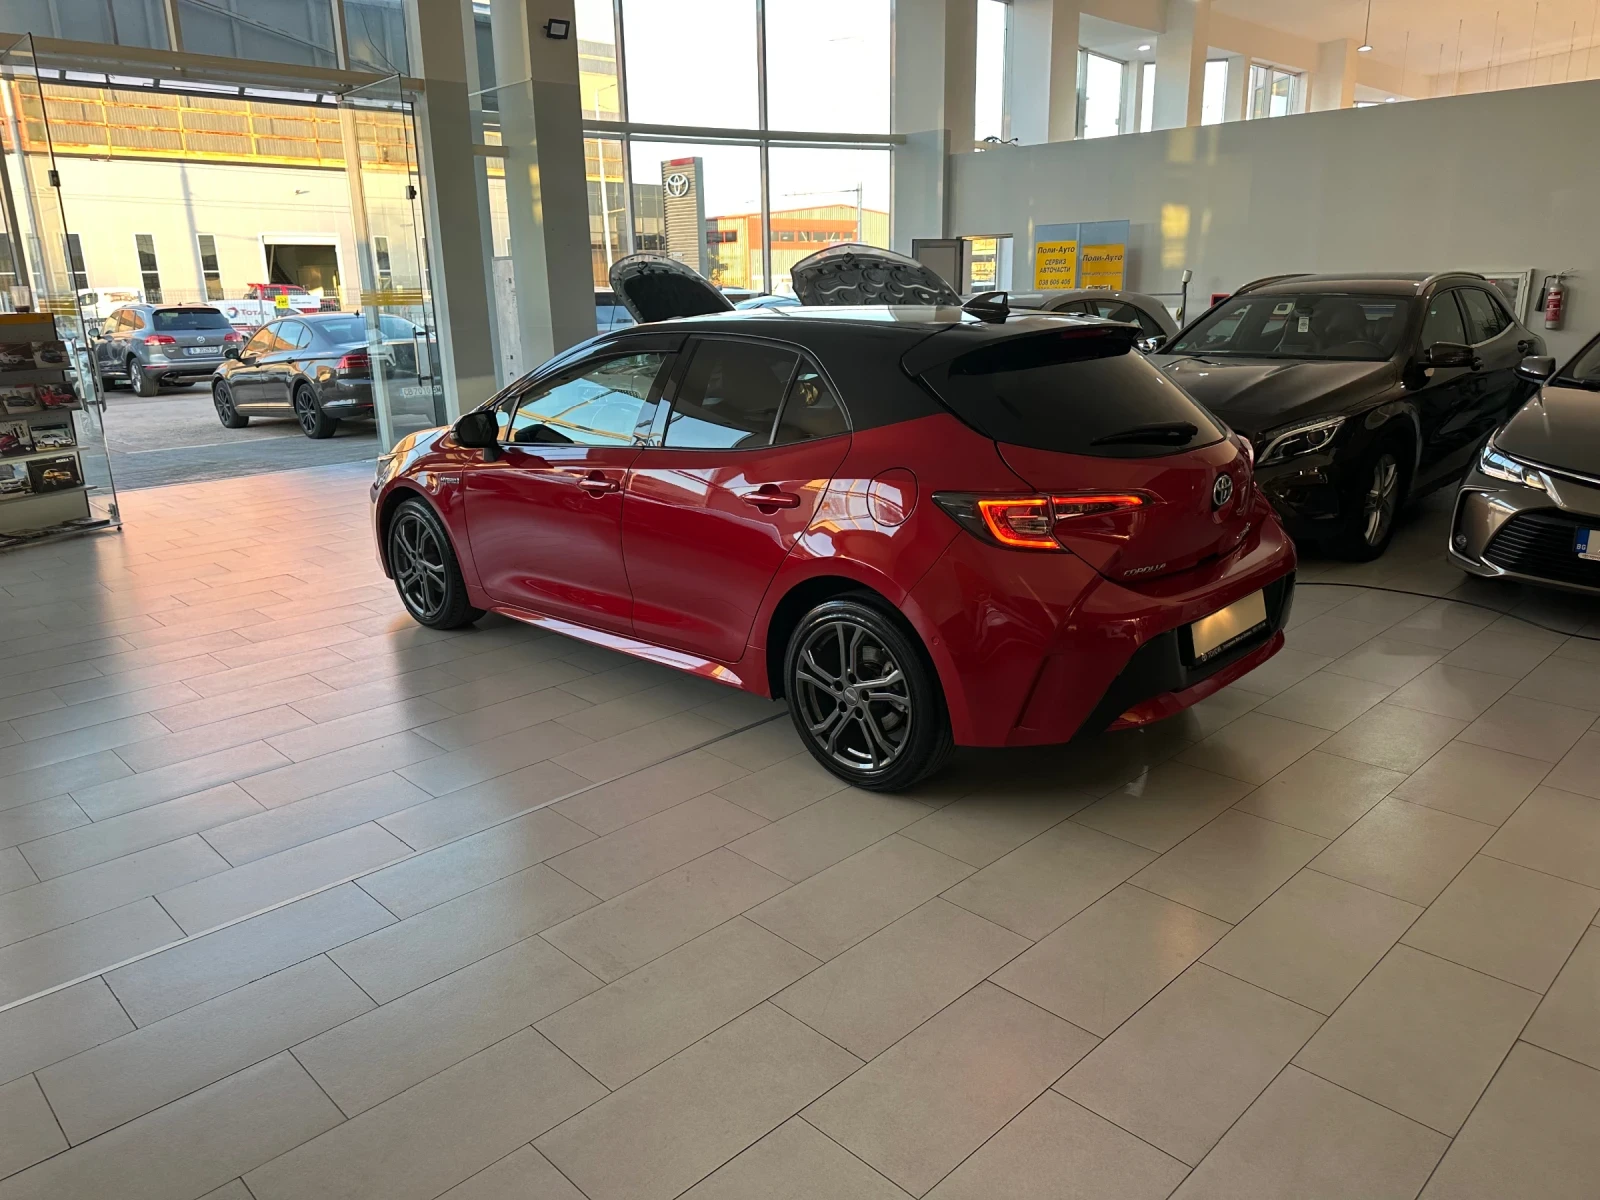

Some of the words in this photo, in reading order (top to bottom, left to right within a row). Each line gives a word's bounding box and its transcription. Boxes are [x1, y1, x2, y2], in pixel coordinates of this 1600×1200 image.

[1037, 246, 1075, 254] Поли-Ауто
[1083, 254, 1122, 262] Поли-Ауто
[1576, 543, 1587, 551] BG
